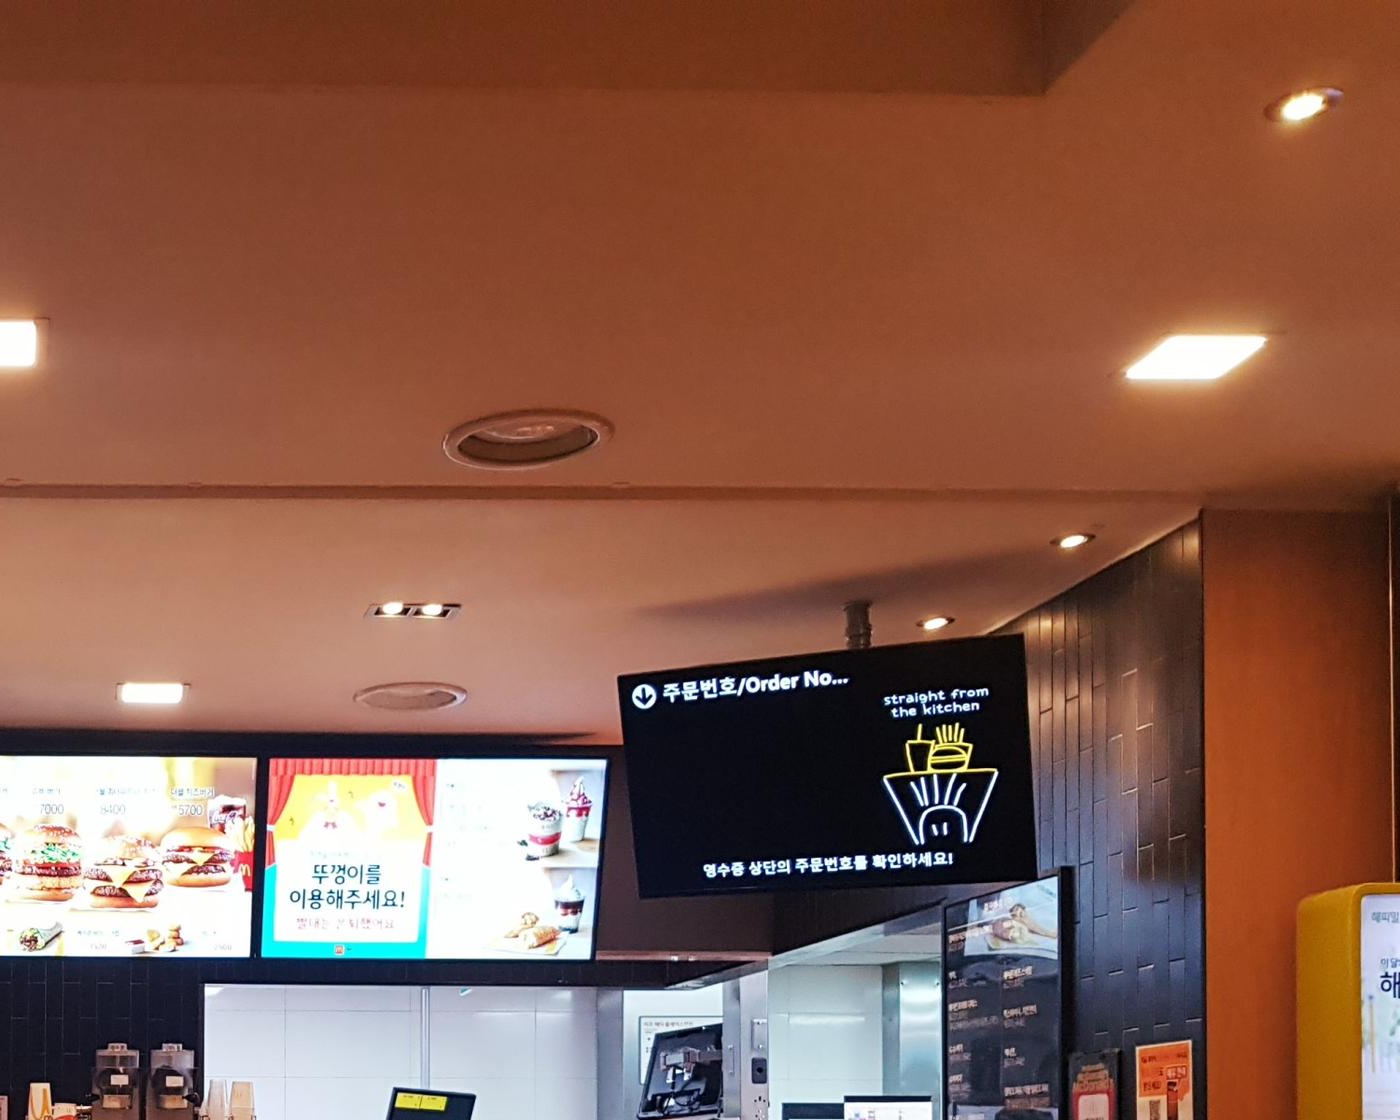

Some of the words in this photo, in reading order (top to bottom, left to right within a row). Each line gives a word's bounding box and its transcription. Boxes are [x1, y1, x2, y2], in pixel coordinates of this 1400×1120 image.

[663, 674, 799, 703] 주문번호/Order
[803, 670, 849, 688] No...
[883, 690, 946, 706] straight
[950, 687, 989, 700] from
[891, 706, 917, 718] the
[922, 701, 980, 716] kitchen
[178, 804, 203, 816] 5700
[311, 864, 382, 885] 뚜껑이를
[702, 861, 745, 879] 영수증
[748, 859, 792, 877] 상단의
[795, 855, 868, 875] 주문번호를
[872, 852, 954, 870] 확인하세요!
[289, 888, 405, 910] 이용해주세요!
[1390, 957, 1400, 969] 달
